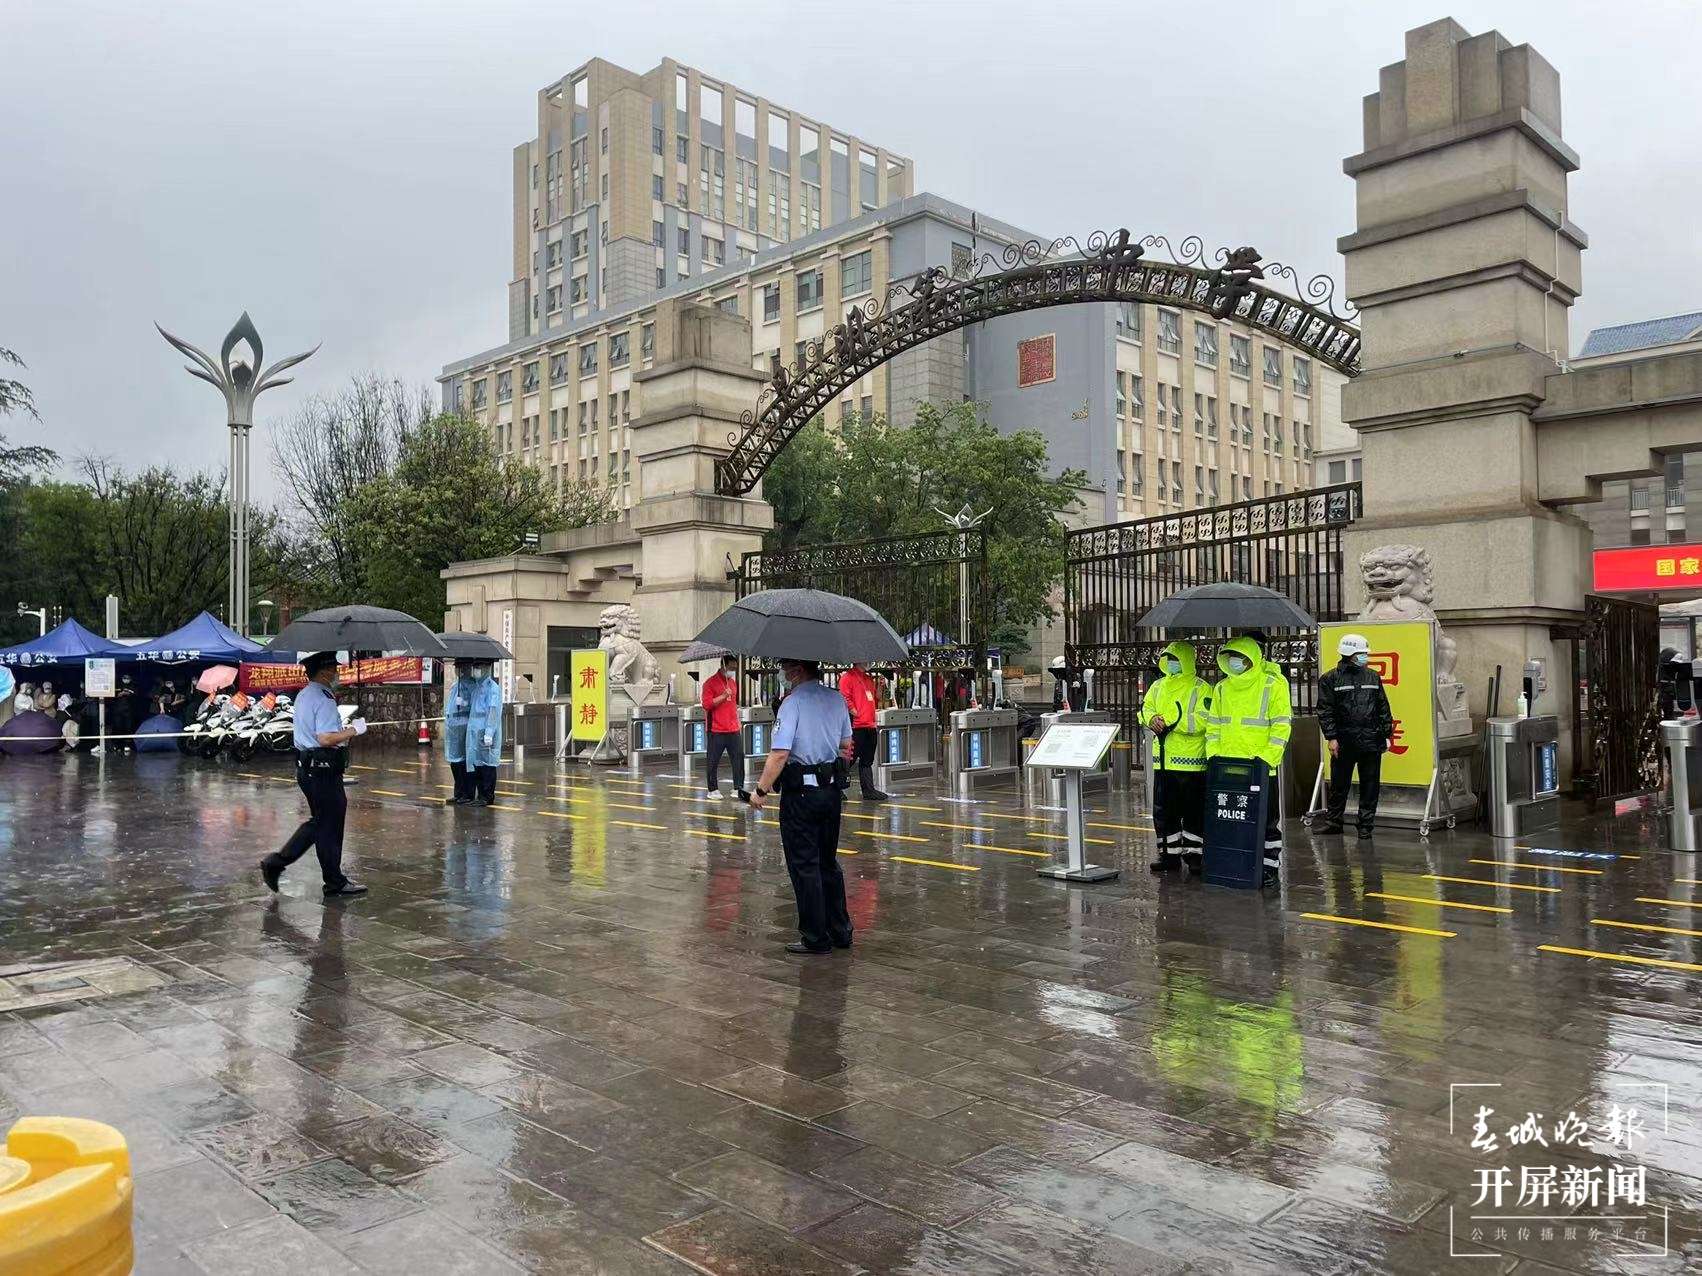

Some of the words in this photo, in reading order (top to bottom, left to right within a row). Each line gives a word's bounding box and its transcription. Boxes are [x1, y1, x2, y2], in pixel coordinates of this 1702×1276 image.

[1656, 557, 1701, 576] 国家
[579, 666, 599, 725] 肃静
[1217, 793, 1249, 808] 警察
[1217, 808, 1246, 820] POLICE
